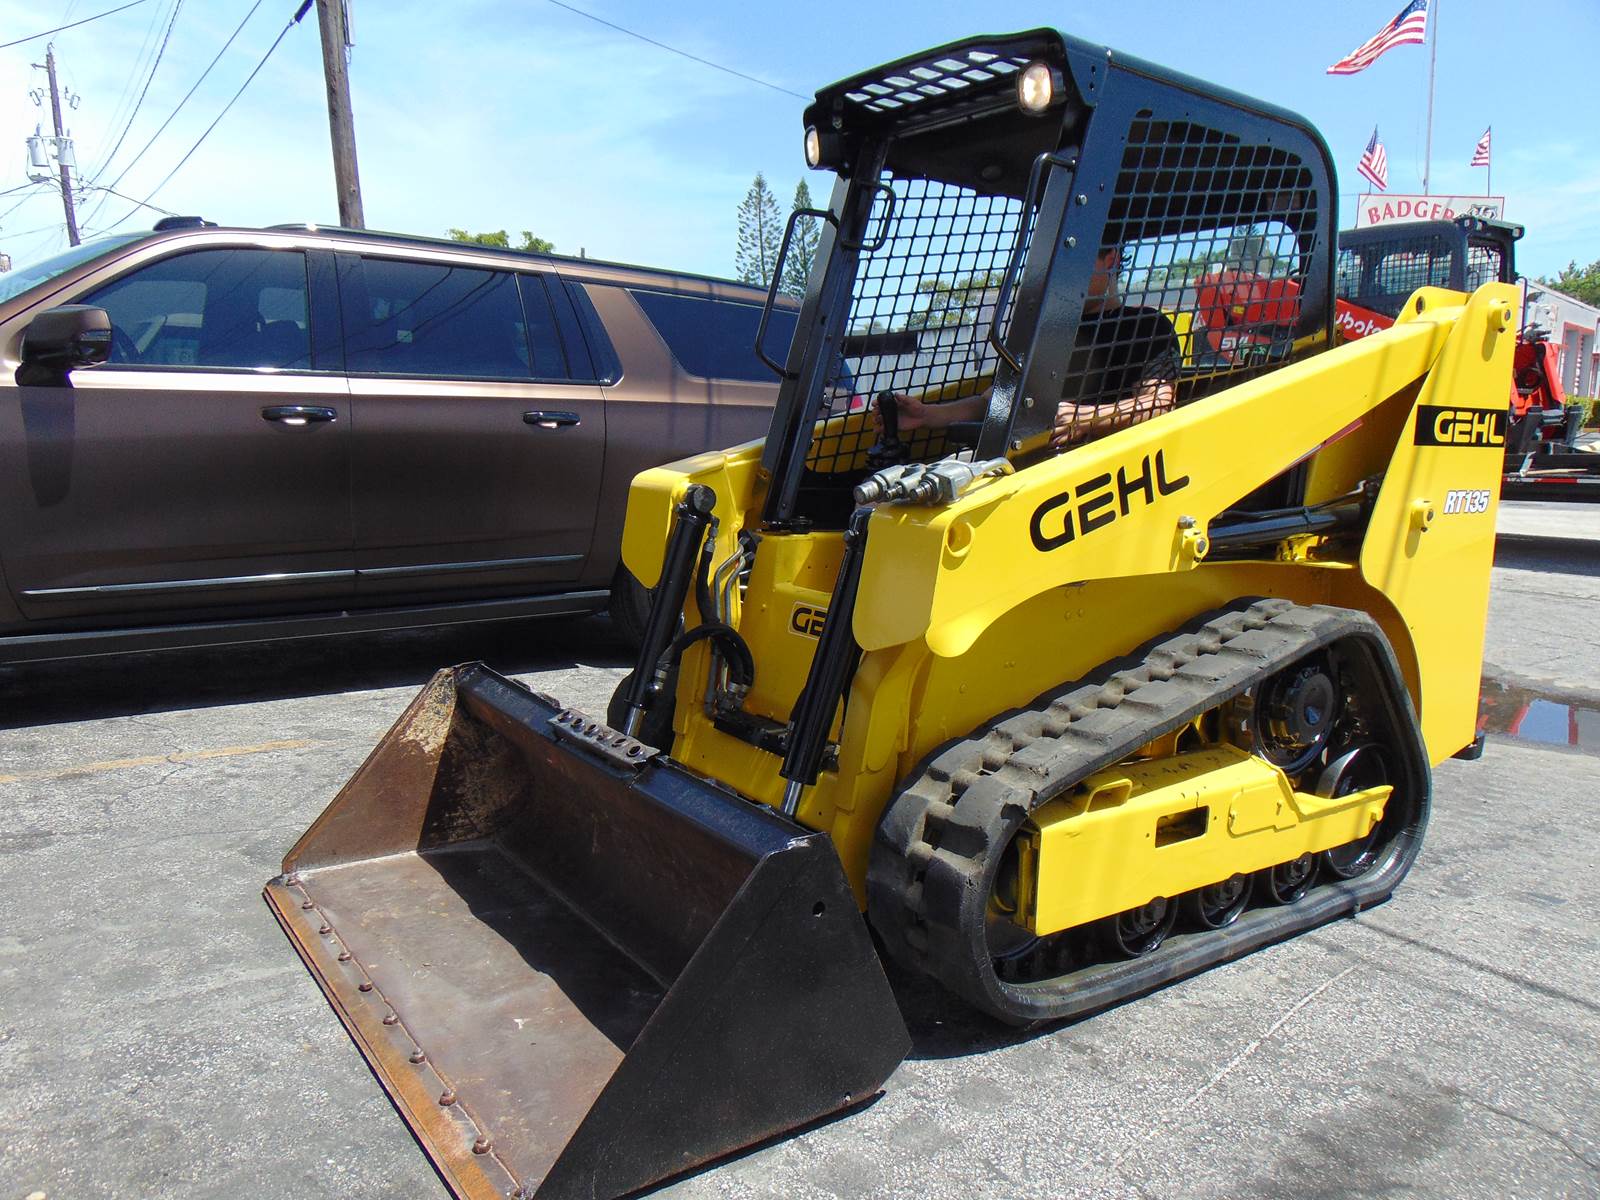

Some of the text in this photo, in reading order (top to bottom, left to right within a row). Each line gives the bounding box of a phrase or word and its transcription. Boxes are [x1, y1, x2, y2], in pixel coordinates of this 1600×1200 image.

[1434, 411, 1504, 444] GEHL
[1030, 448, 1190, 552] GEHL
[1443, 490, 1490, 514] RT135
[792, 607, 828, 637] GE
